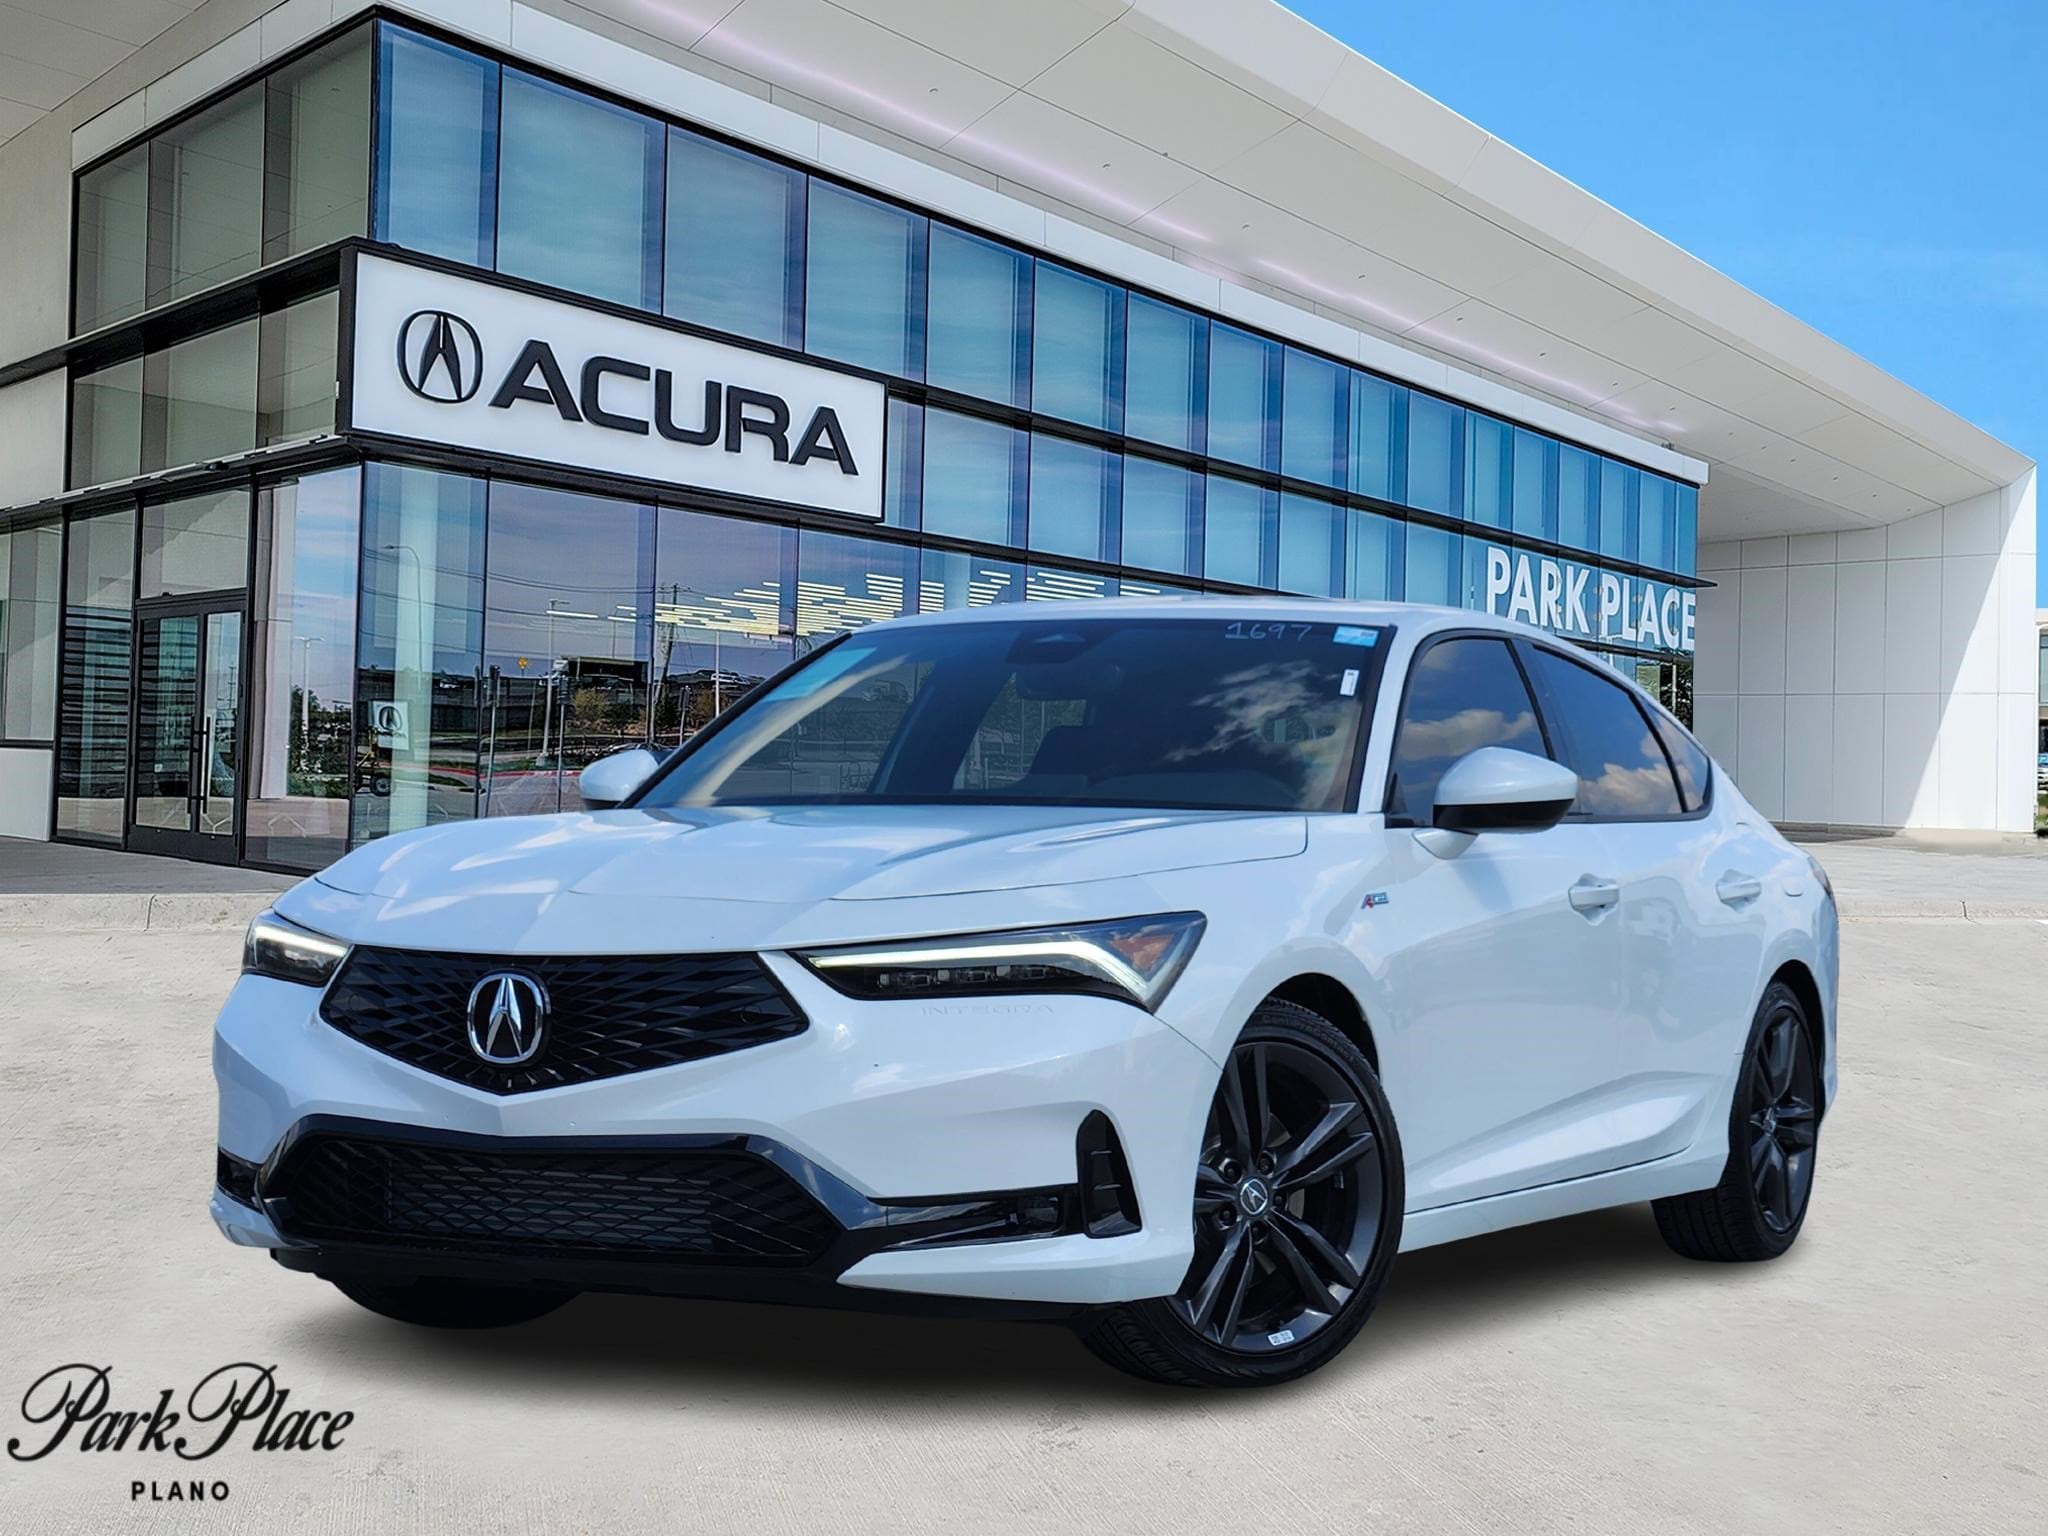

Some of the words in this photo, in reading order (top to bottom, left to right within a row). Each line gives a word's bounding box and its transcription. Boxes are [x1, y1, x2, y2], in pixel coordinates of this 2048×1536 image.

[488, 339, 859, 476] ACURA
[1225, 622, 1312, 639] 1697
[1486, 546, 1590, 634] PARK
[1601, 573, 1696, 650] PLACE
